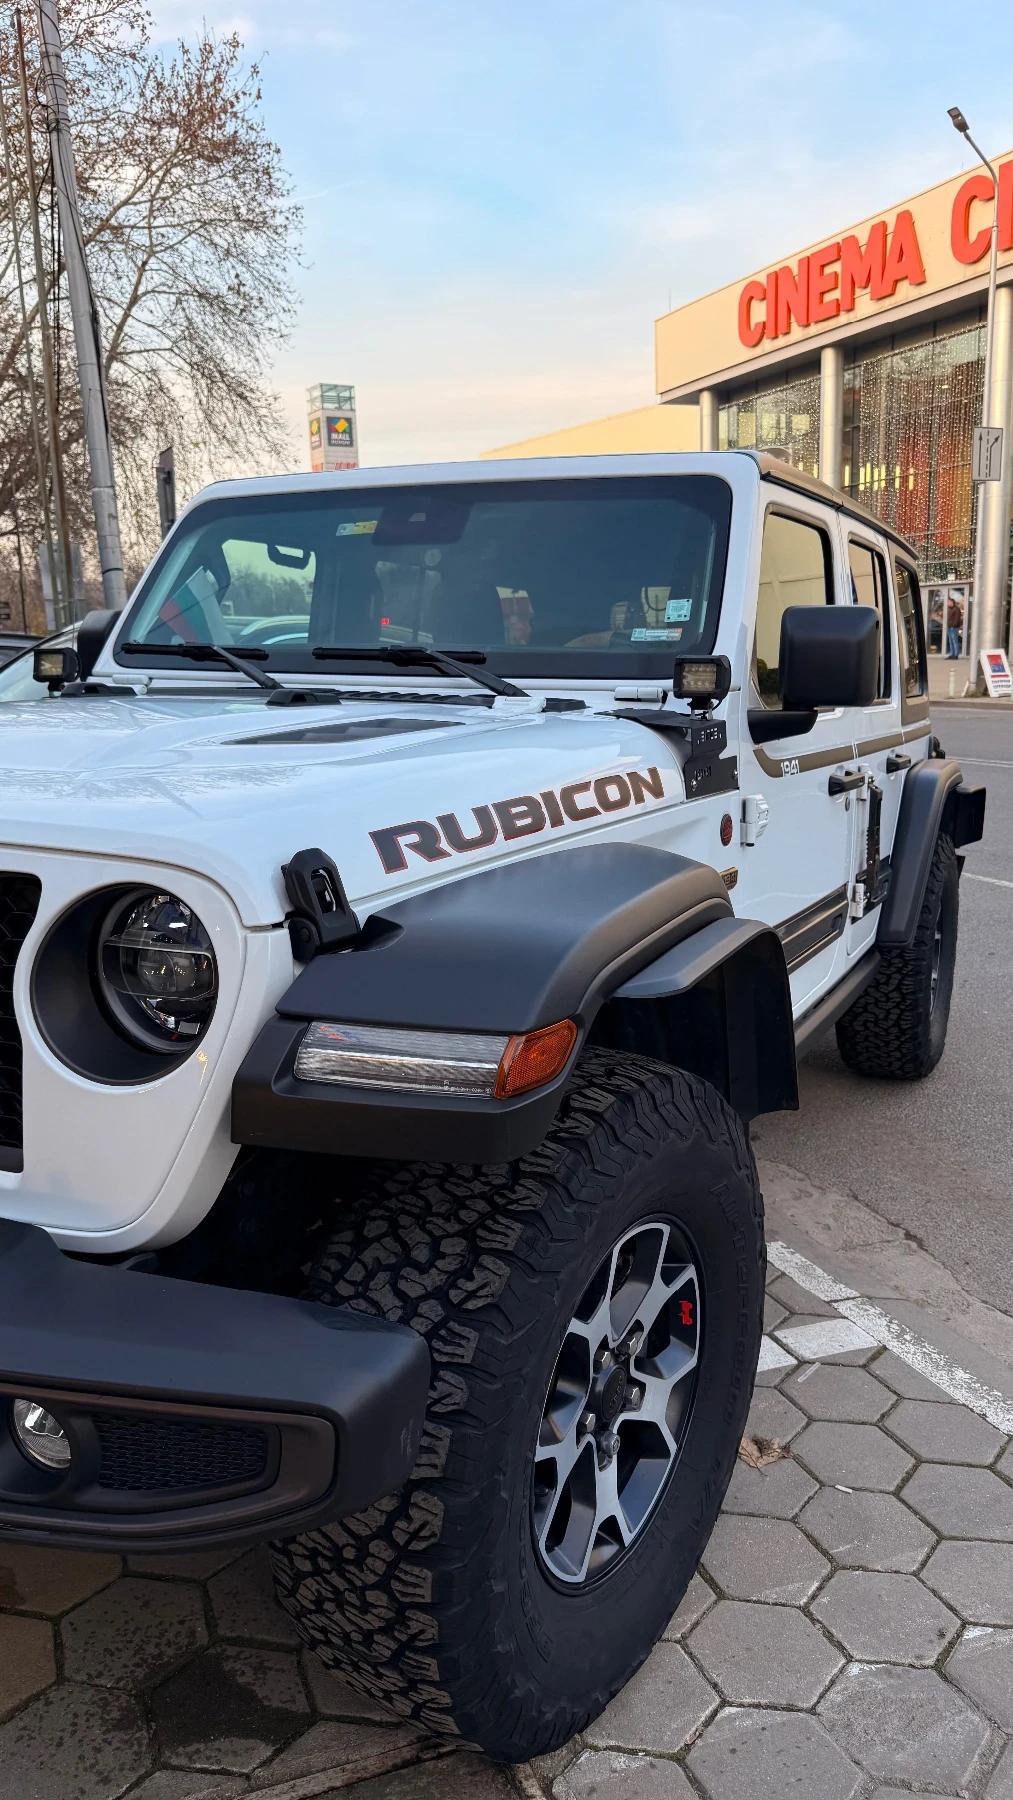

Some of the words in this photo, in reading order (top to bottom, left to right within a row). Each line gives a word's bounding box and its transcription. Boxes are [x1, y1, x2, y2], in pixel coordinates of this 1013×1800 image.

[738, 209, 927, 347] CINEMA
[368, 766, 665, 875] RUBICON
[780, 759, 800, 777] 1941
